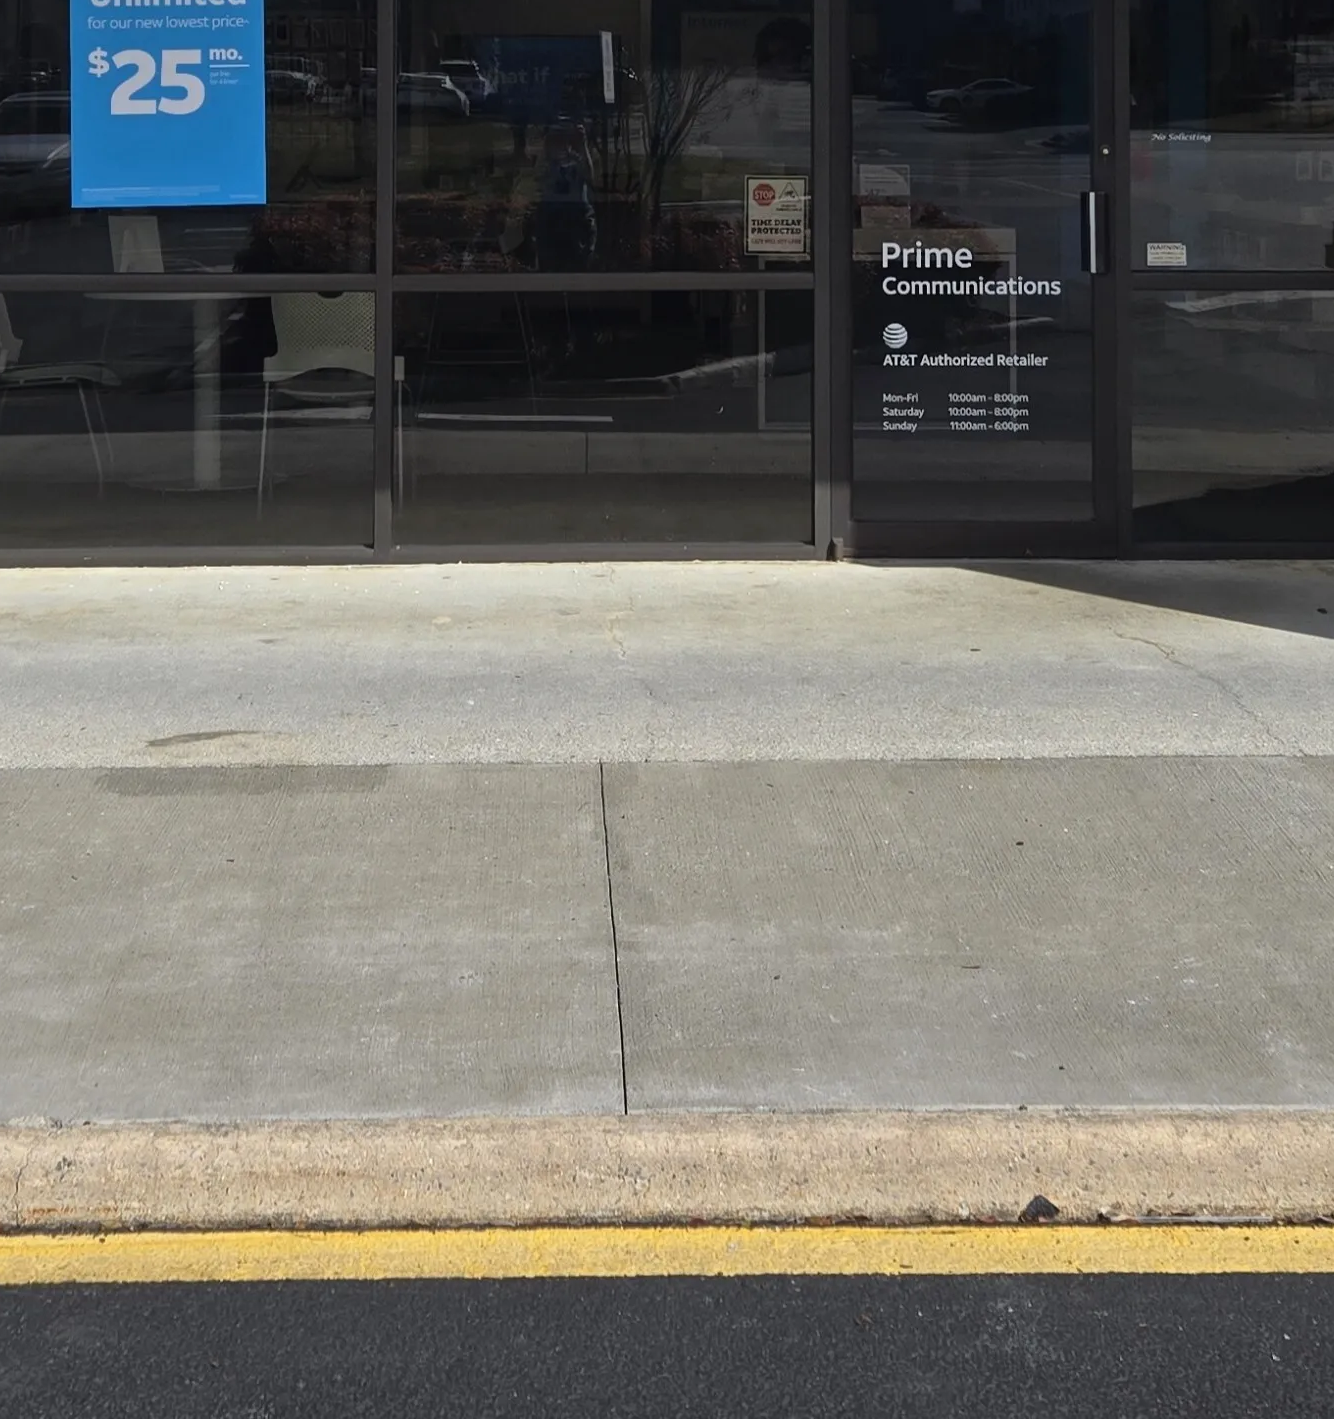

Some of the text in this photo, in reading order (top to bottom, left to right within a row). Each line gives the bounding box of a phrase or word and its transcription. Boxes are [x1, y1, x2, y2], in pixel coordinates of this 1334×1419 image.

[87, 16, 108, 29] for
[109, 19, 132, 29] our
[135, 18, 163, 28] new
[166, 15, 209, 28] lowest
[209, 47, 243, 61] mo.
[1151, 132, 1166, 141] No
[754, 190, 775, 200] STOP
[751, 227, 802, 235] PROTECTED
[881, 240, 973, 269] Prime
[881, 276, 1062, 296] Communications
[882, 353, 1049, 367] AT&T Authorized Retailer
[882, 393, 919, 403] Mon-Fri
[948, 393, 986, 403] 10:00am
[994, 393, 1029, 404] 8:00pm
[882, 407, 925, 419] Saturday
[948, 407, 986, 417] 10:00am
[994, 407, 1029, 418] 8:00pm
[882, 421, 918, 433] Sunday
[950, 421, 987, 431] 11:00am
[994, 421, 1030, 432] 6:00pm
